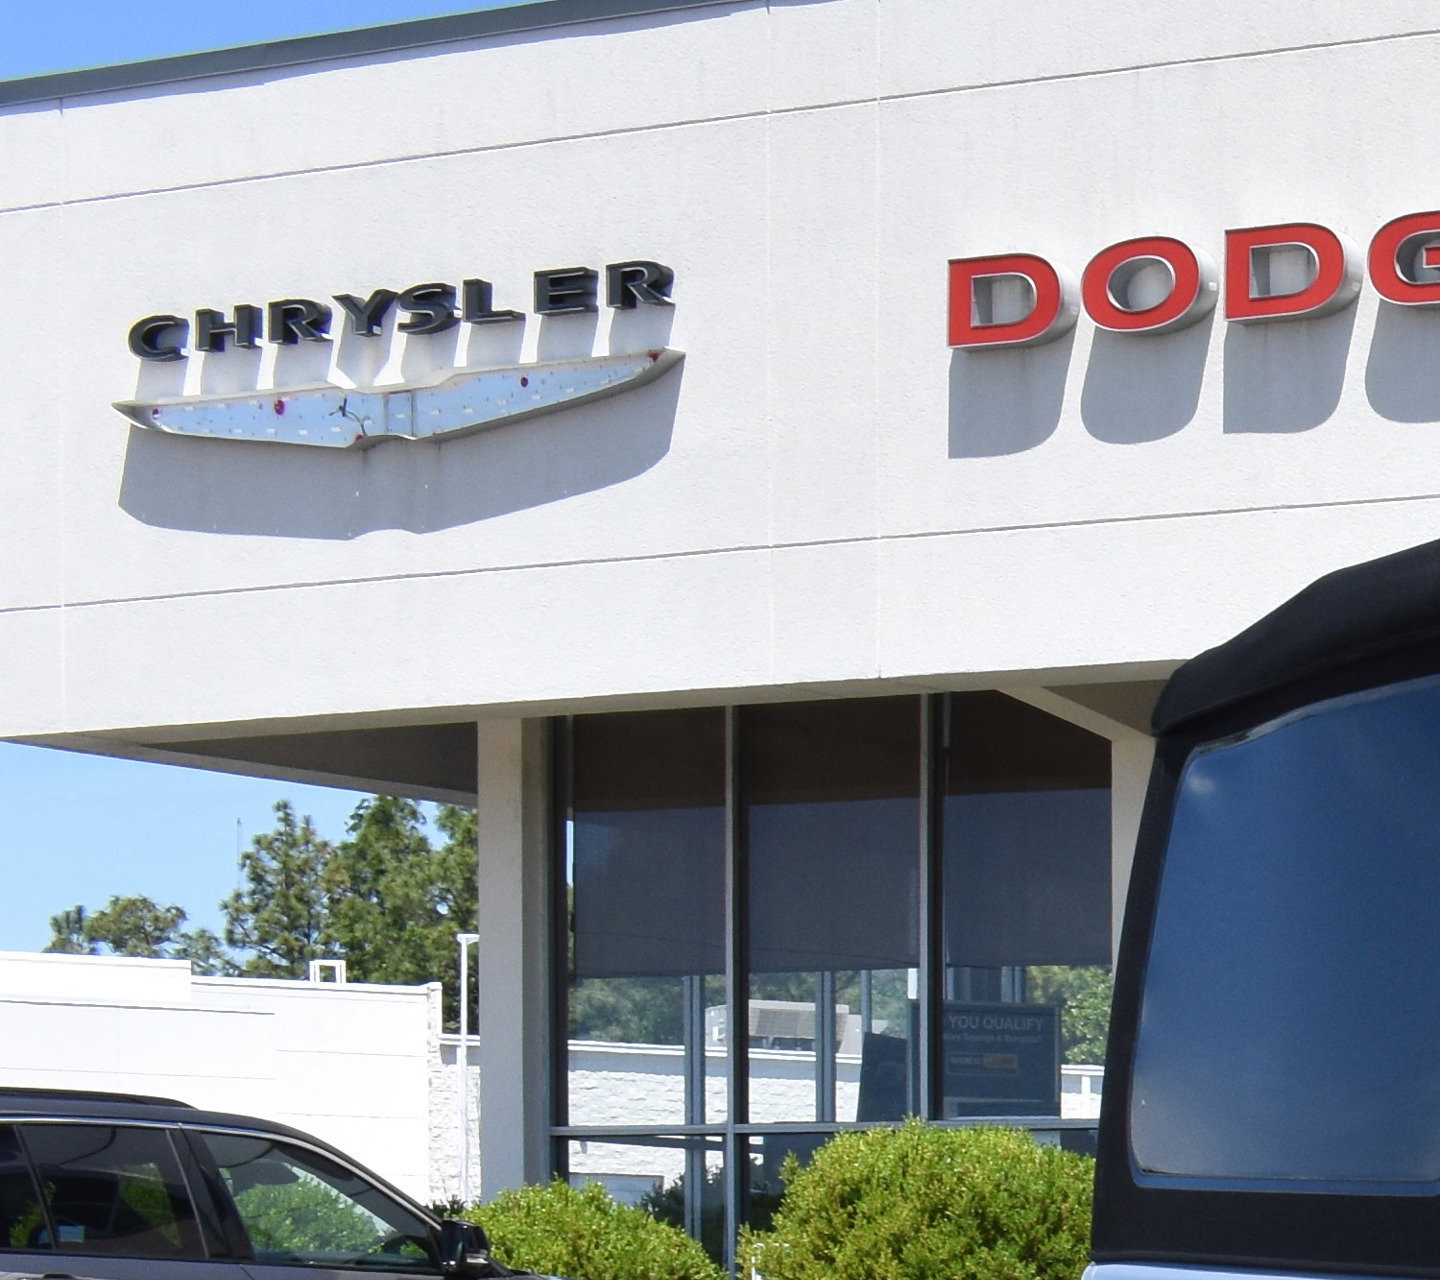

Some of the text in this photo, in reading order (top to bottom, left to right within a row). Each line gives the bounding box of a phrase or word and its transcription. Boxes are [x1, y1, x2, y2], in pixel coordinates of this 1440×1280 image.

[127, 260, 676, 362] CHRYSLER
[949, 1015, 1044, 1032] YOU QUALIFY
